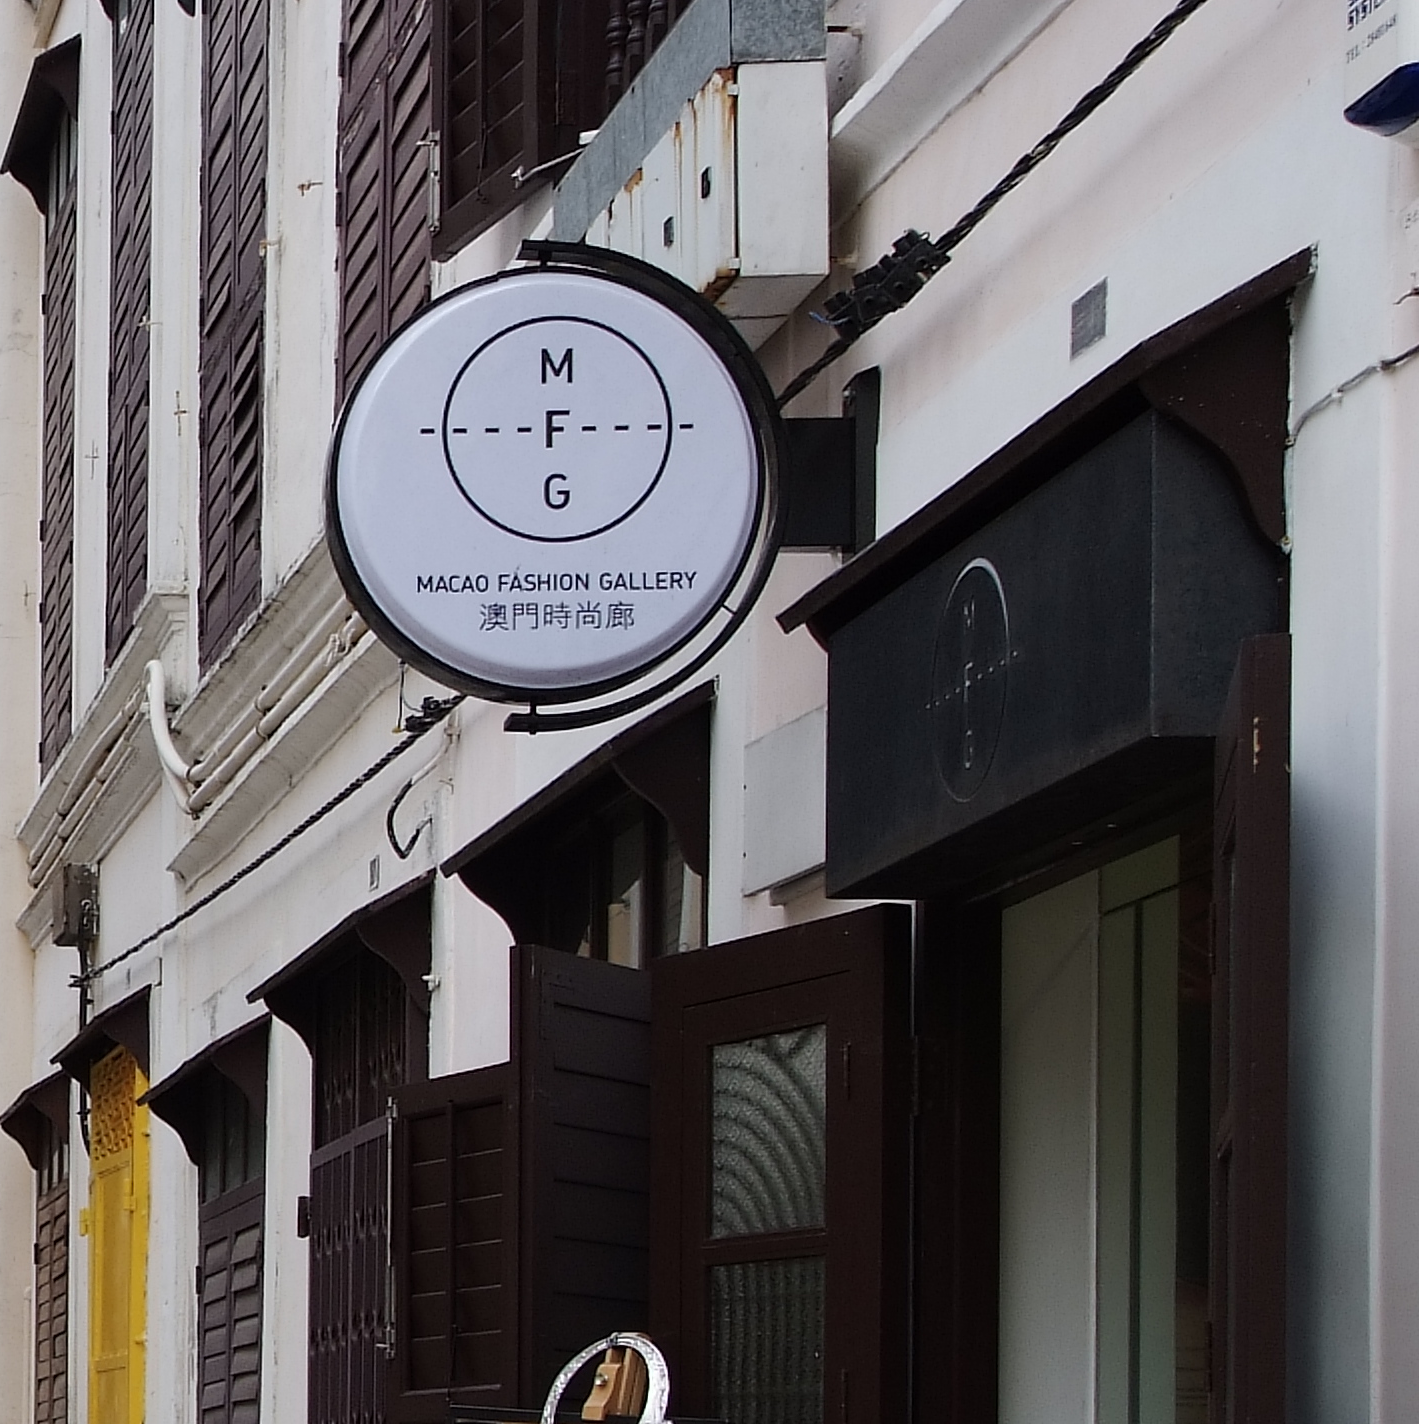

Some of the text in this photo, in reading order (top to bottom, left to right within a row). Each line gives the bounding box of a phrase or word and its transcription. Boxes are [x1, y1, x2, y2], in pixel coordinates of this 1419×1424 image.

[541, 348, 573, 384] M
[545, 410, 570, 448] F
[544, 473, 570, 510] G
[416, 571, 698, 594] MACAO FASHION GALLERY
[479, 600, 636, 632] 澳門時尚廊
